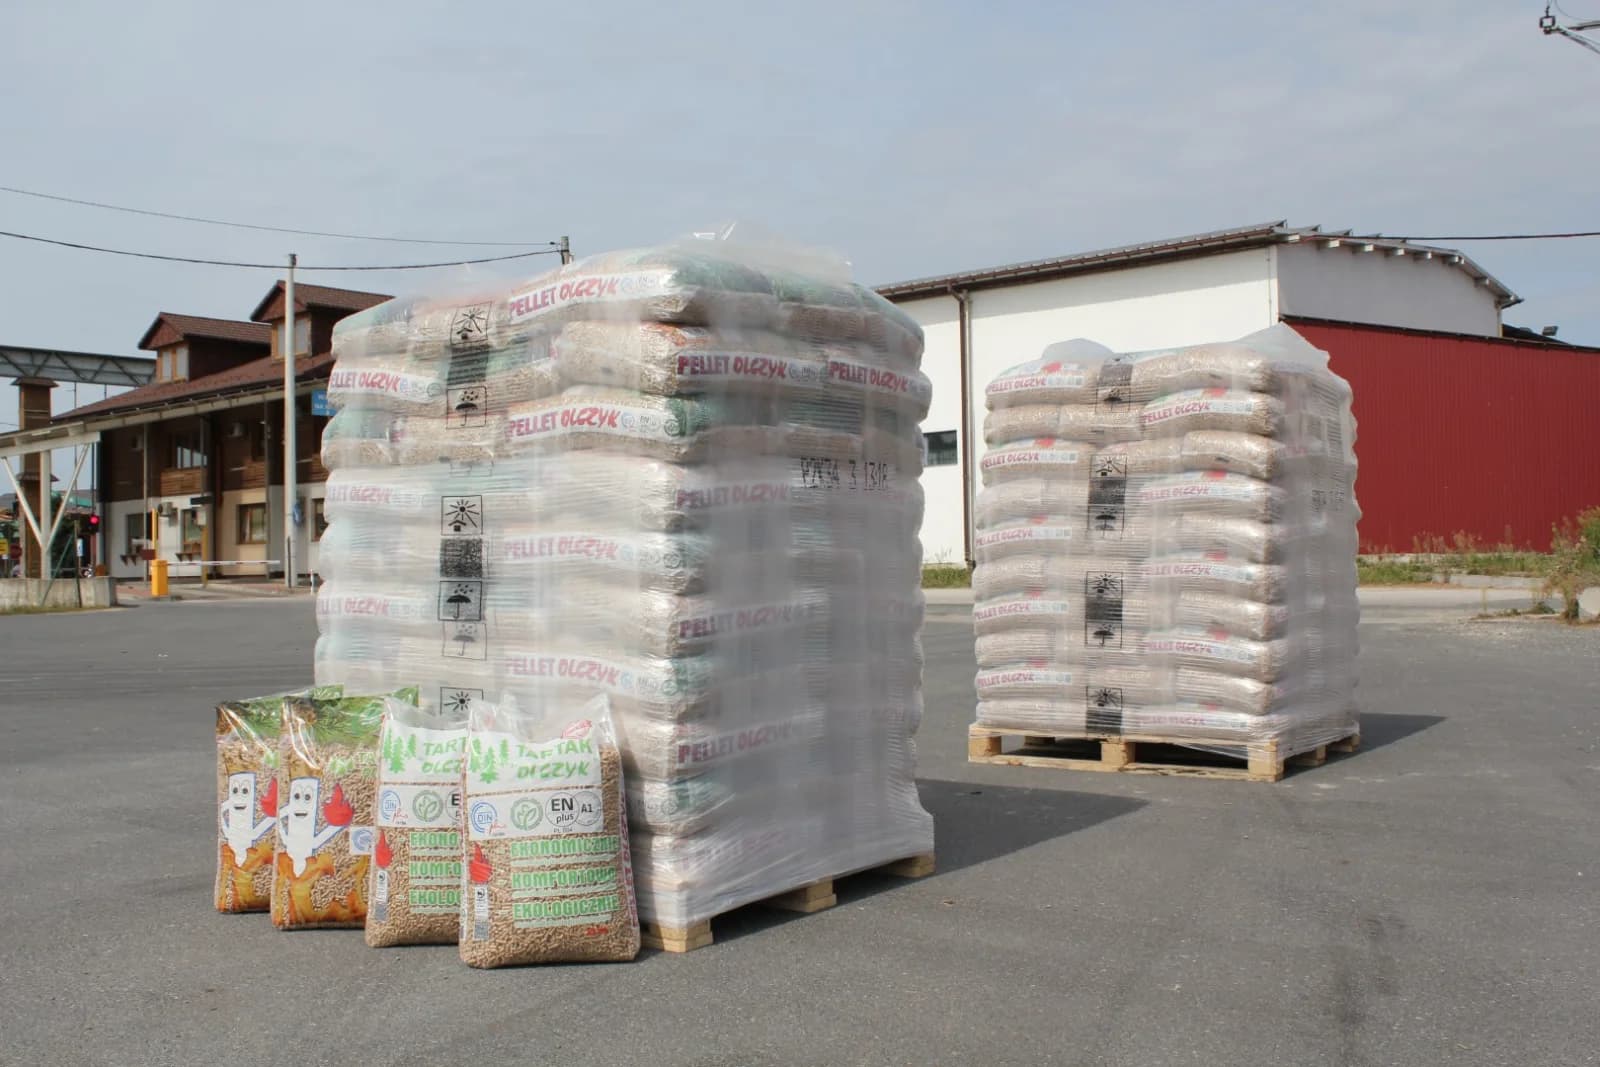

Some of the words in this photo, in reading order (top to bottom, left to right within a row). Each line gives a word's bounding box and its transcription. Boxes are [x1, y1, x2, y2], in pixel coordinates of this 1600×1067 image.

[510, 287, 557, 316] PELLET
[677, 355, 730, 375] PELLET
[830, 361, 868, 384] PELLET
[510, 412, 559, 436] PELLET
[504, 536, 554, 560] PELLET
[505, 656, 556, 676] PELLET
[551, 798, 574, 812] EN
[581, 804, 593, 813] A1
[477, 814, 493, 822] DIN
[556, 814, 574, 825] plus
[511, 836, 619, 857] EKONOMICZNIE
[513, 895, 619, 918] EKOLOGICZNIE
